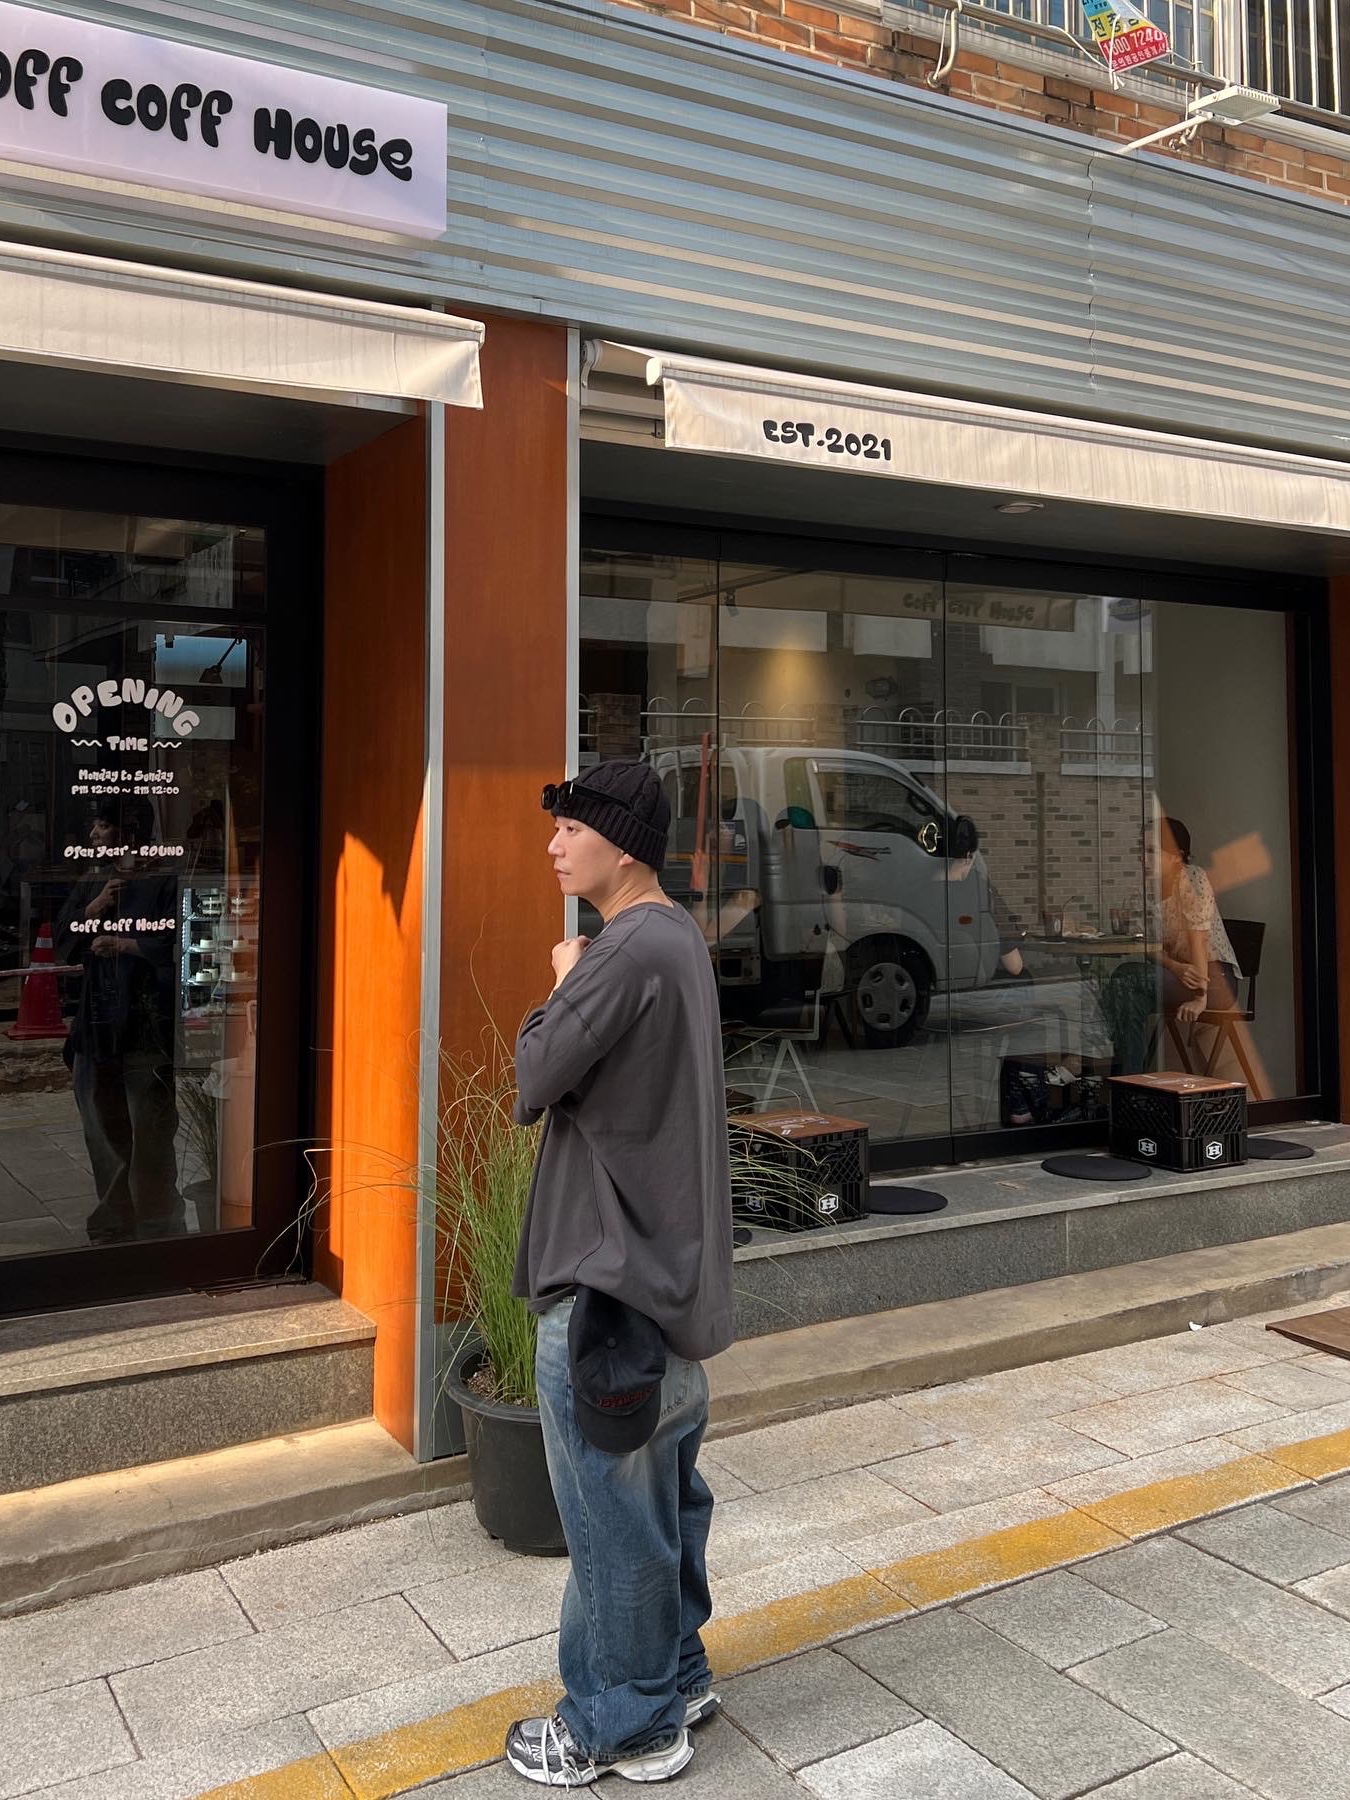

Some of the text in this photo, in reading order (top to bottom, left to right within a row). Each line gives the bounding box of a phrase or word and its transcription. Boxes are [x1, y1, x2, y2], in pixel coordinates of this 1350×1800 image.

[763, 420, 891, 460] EST.2021
[52, 678, 200, 736] OPENING
[78, 769, 174, 783] Monday to Sunday
[91, 786, 120, 795] 12:00
[151, 786, 179, 795] 12:00
[140, 846, 184, 857] ROUND
[69, 919, 175, 933] Coff Coff House
